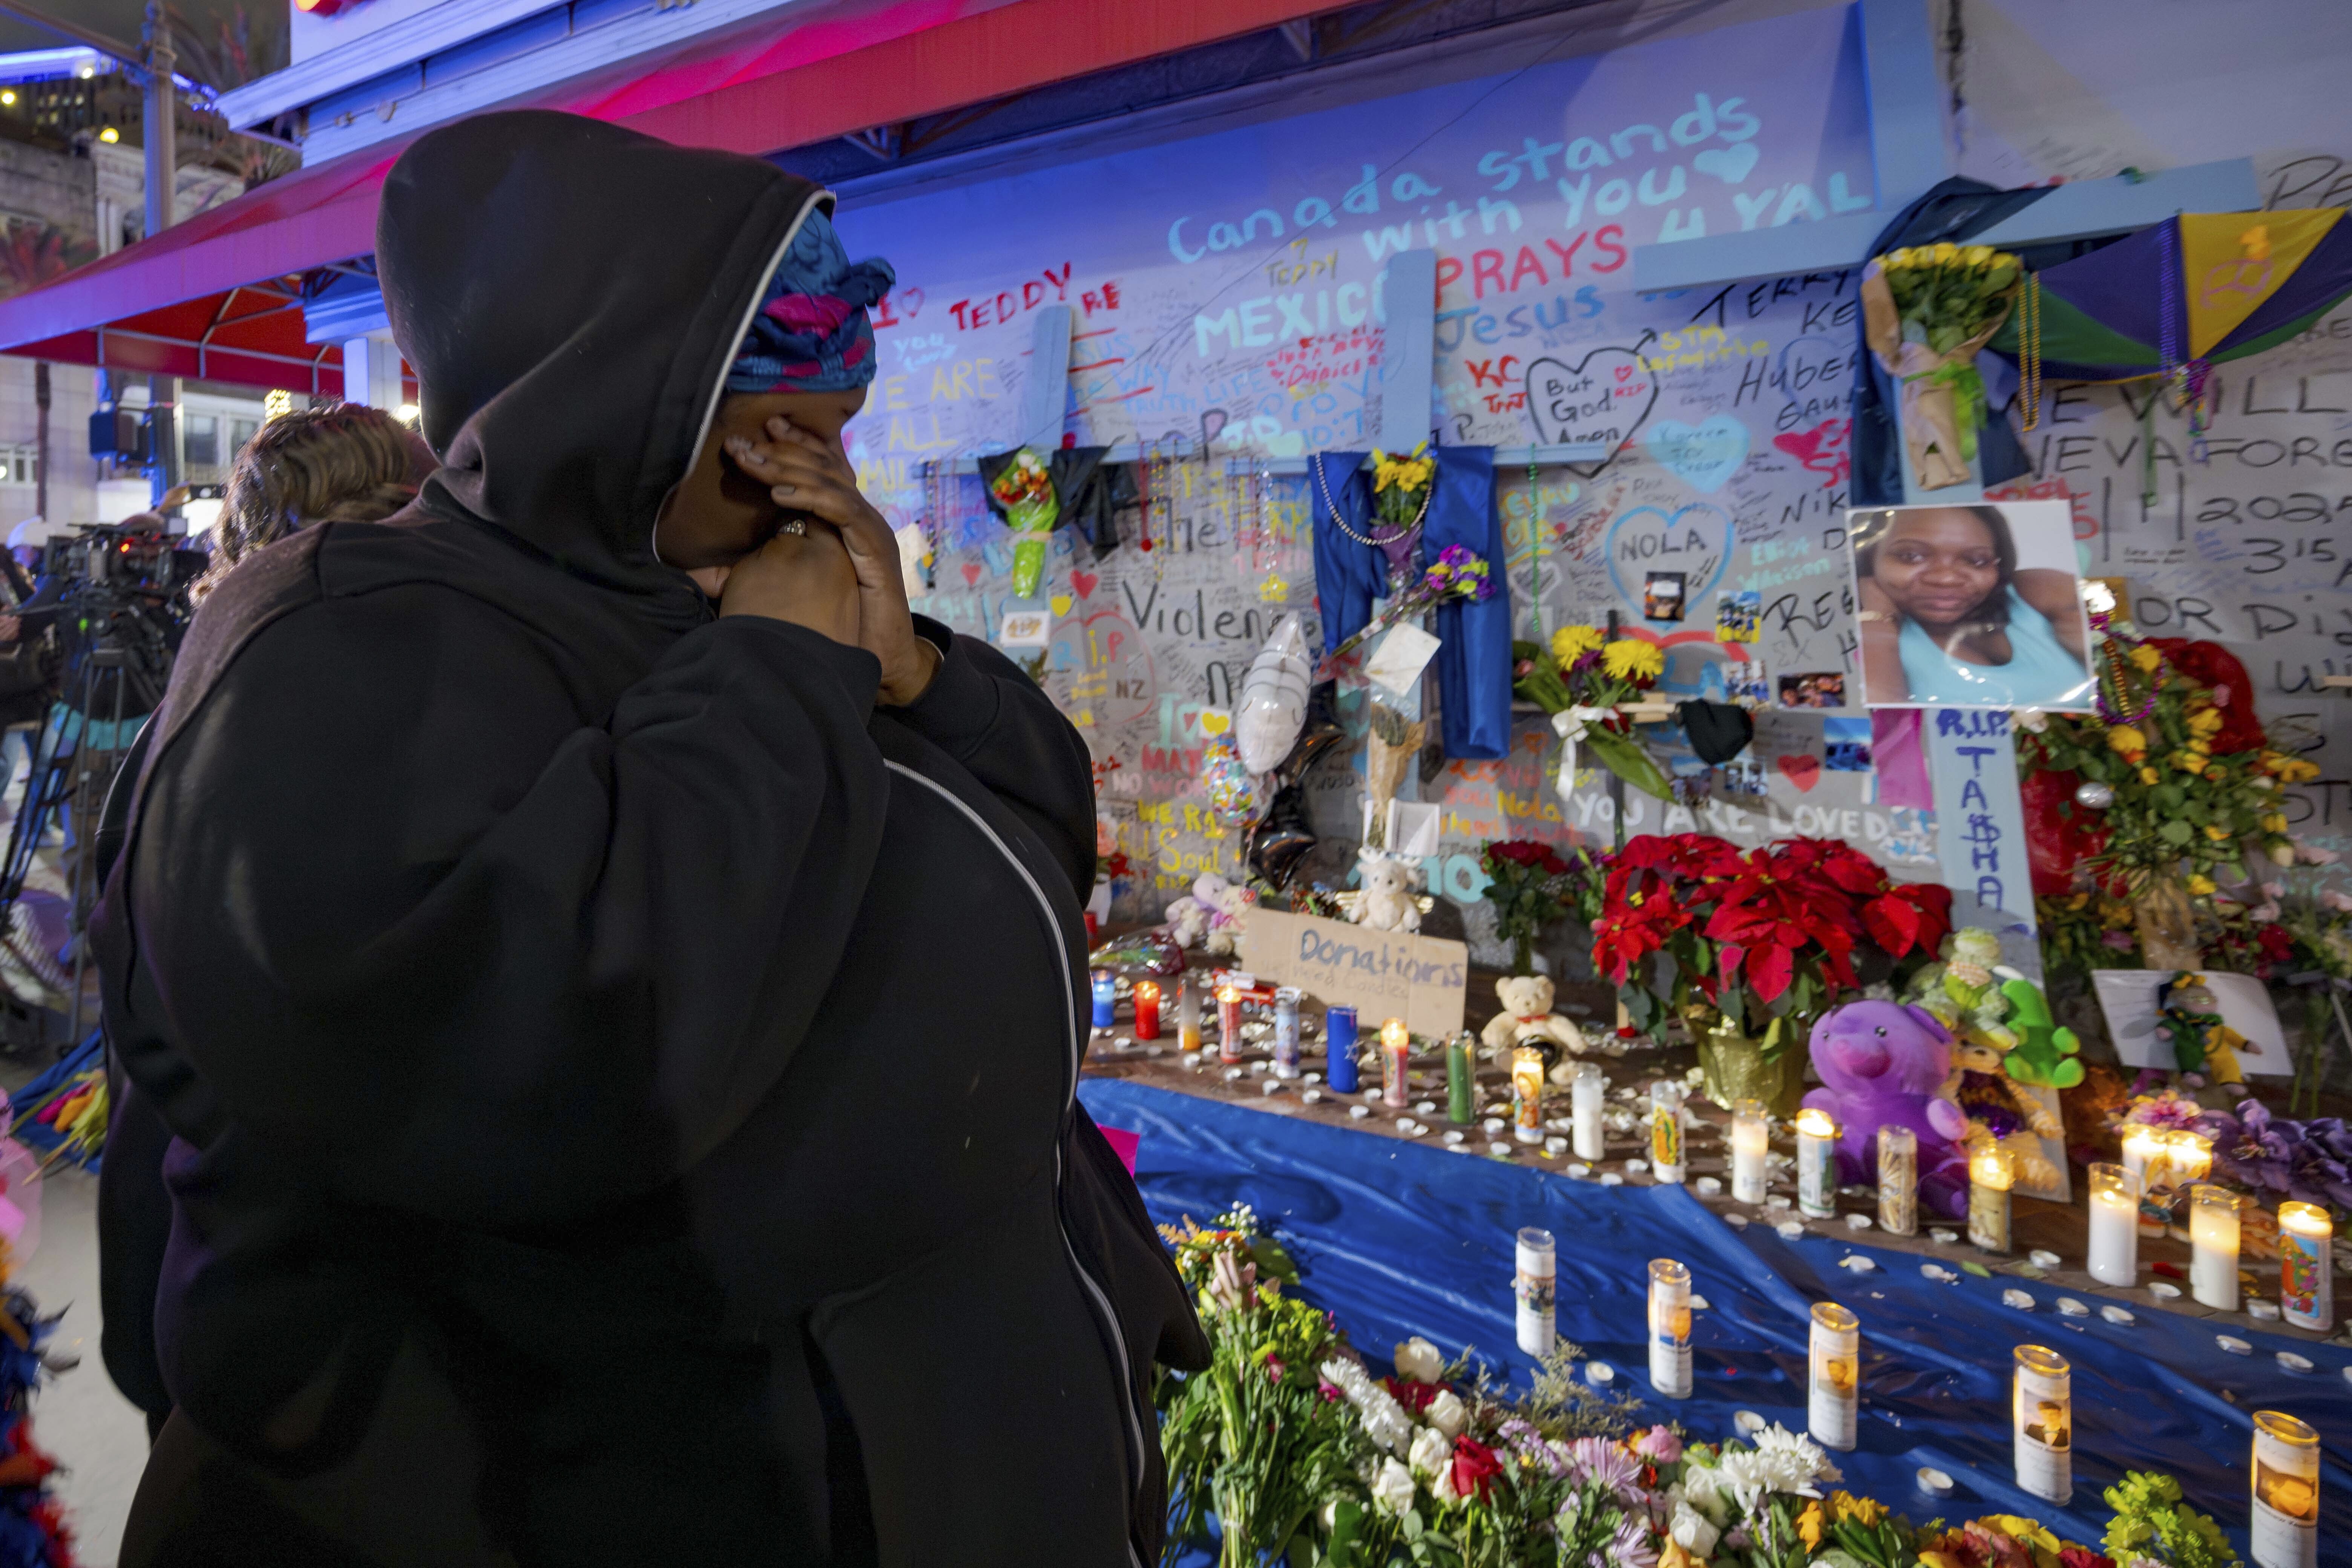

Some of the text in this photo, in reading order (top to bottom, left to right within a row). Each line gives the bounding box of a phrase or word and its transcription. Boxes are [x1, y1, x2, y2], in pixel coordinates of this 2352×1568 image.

[1168, 92, 1762, 264] Canada stands
[1362, 164, 1687, 261] with you
[1435, 225, 1627, 308] PRAYS
[949, 260, 1072, 331] TEDDY
[1800, 300, 1856, 335] KE
[930, 357, 999, 403] ARE
[1546, 376, 1594, 397] But
[888, 413, 958, 452] ALL
[1619, 528, 1707, 561] NOLA
[1147, 776, 1208, 798] WOR
[1663, 797, 1756, 834] ARE
[1769, 803, 1887, 841] LOVED
[1300, 929, 1464, 988] Donations
